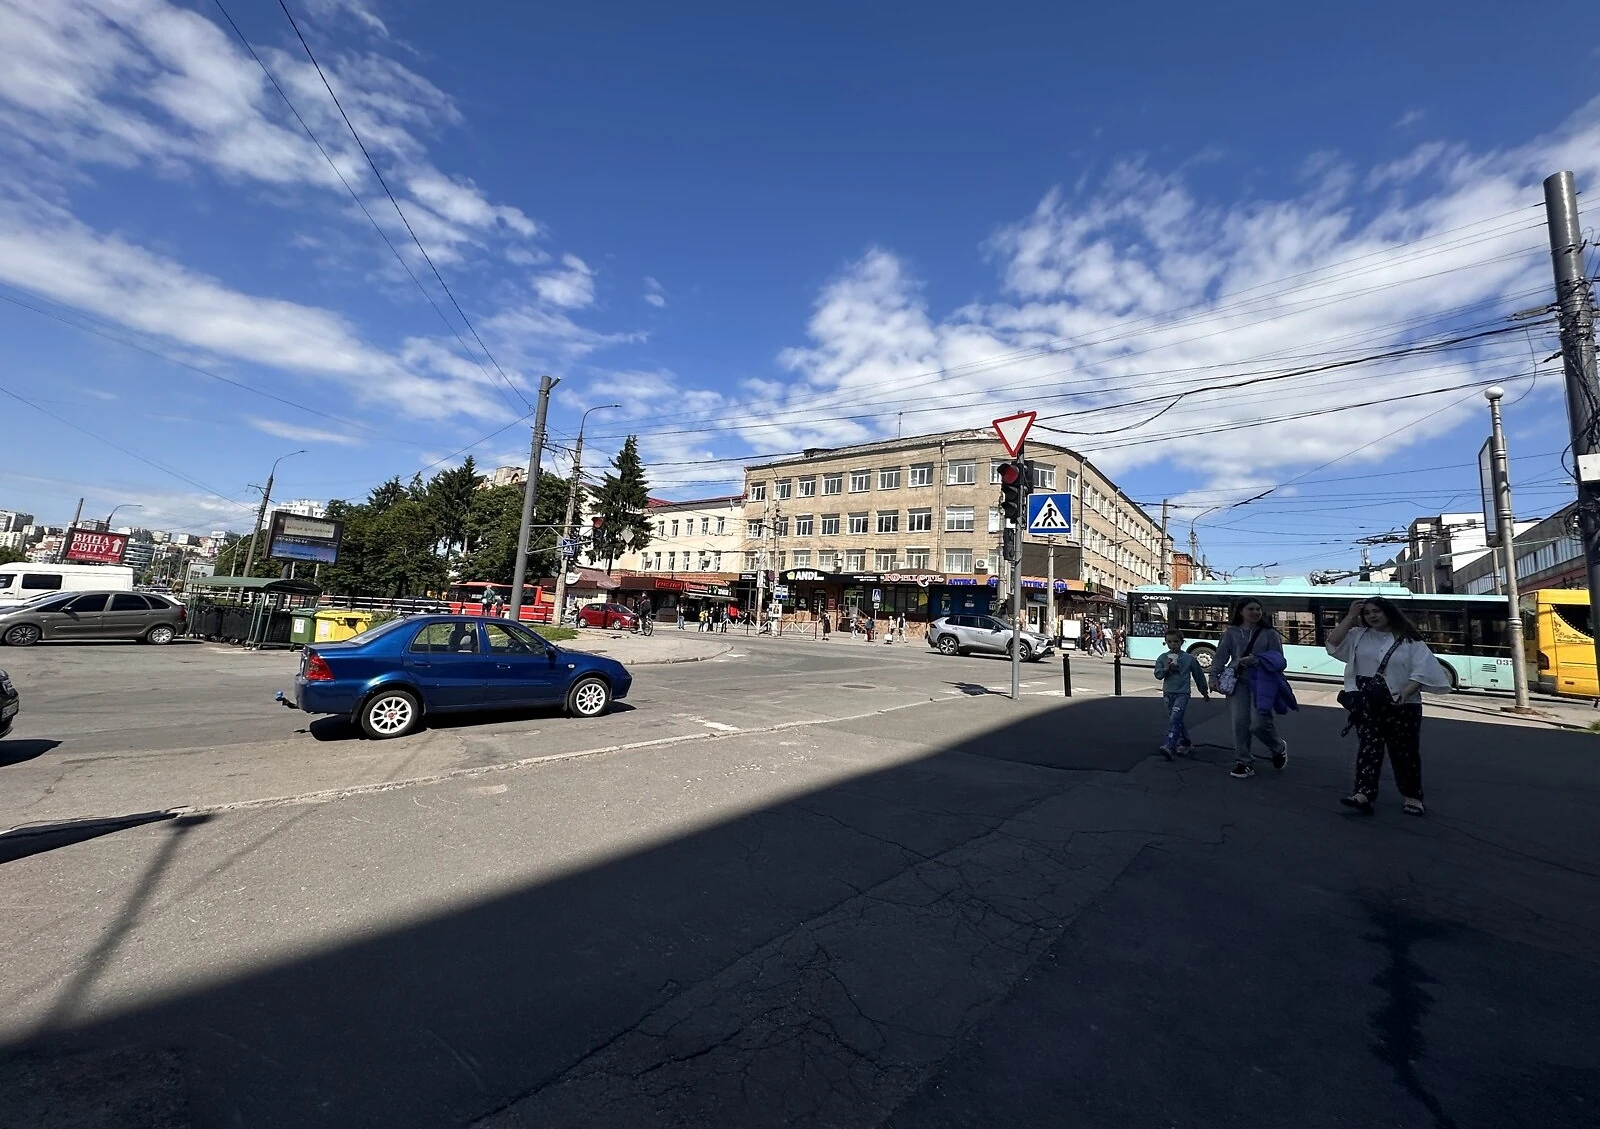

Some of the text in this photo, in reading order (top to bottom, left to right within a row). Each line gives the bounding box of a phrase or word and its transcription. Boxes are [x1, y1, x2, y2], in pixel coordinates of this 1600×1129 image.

[73, 533, 110, 545] ВИНА
[70, 542, 109, 553] СВІТУ
[1021, 580, 1048, 588] ПТЕКА
